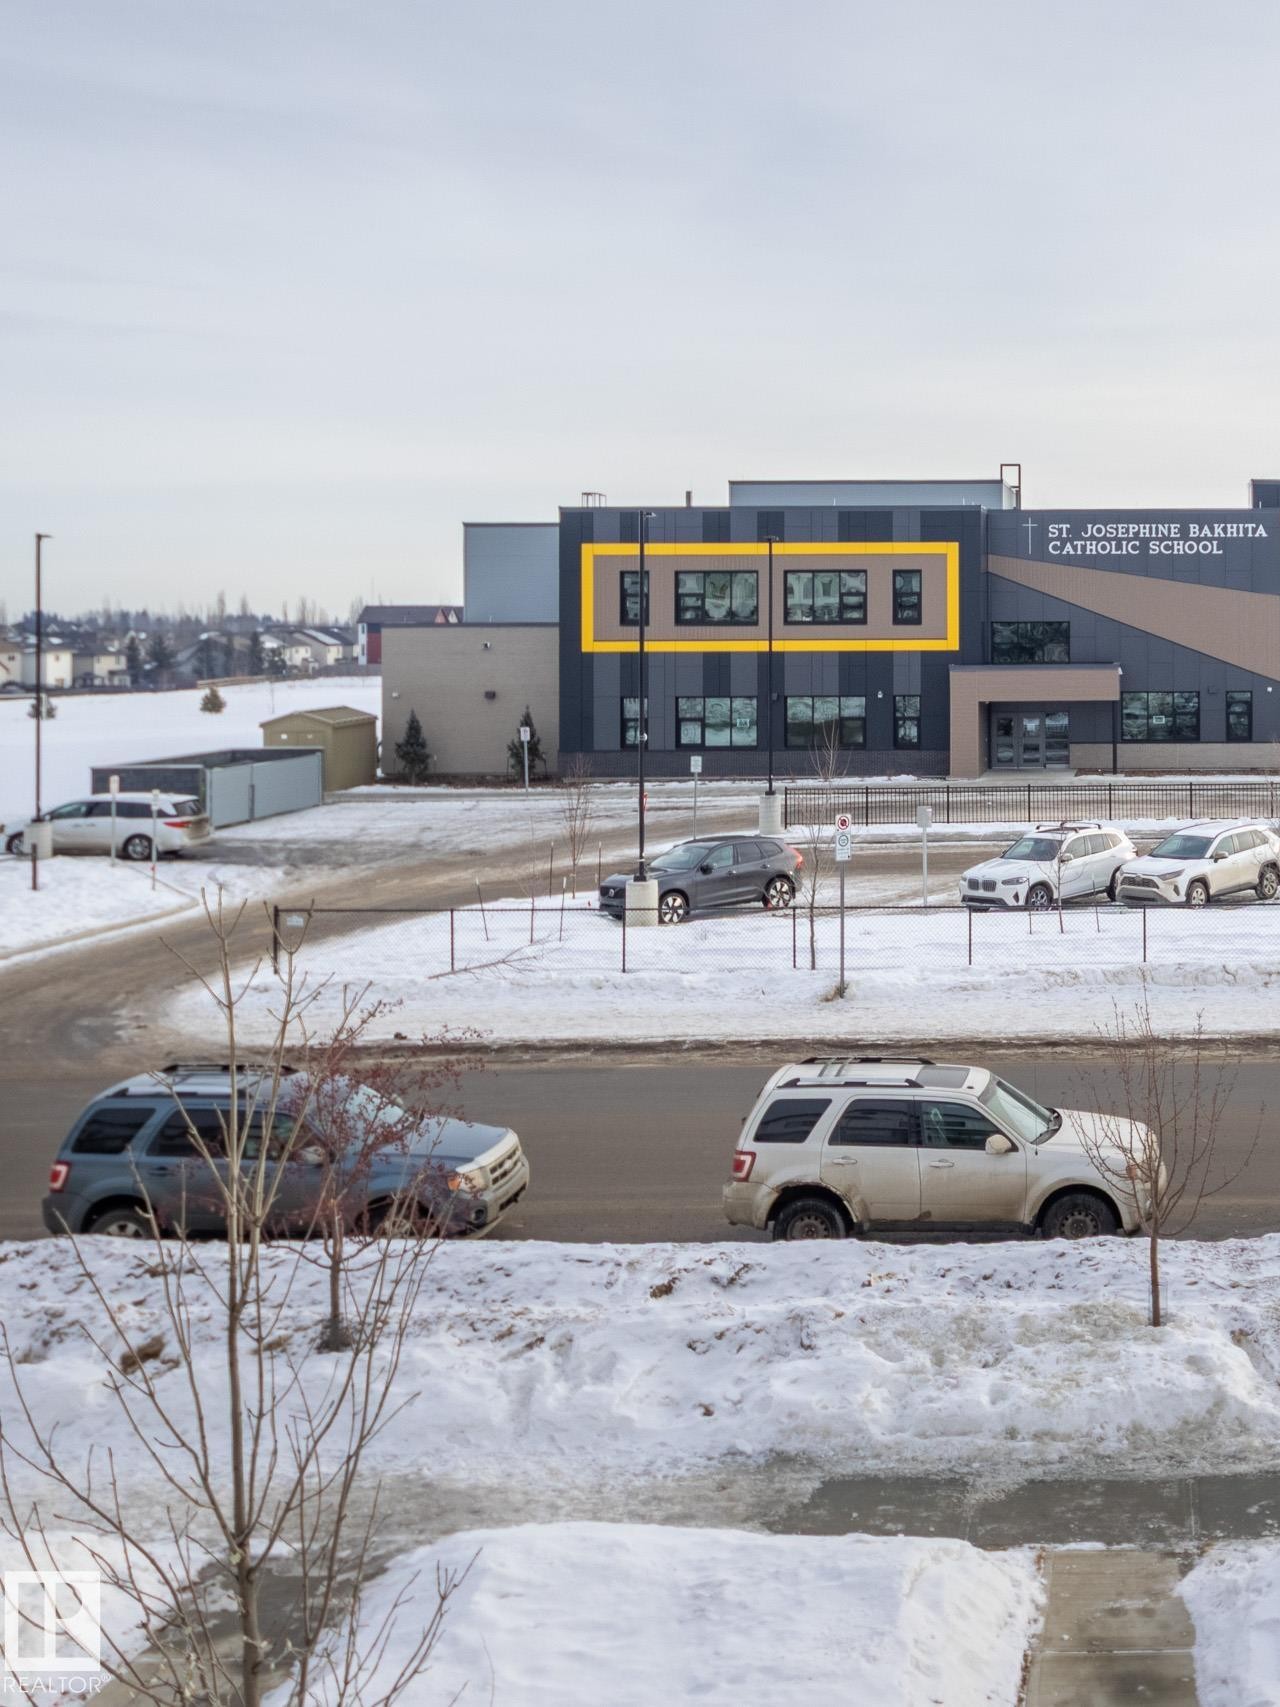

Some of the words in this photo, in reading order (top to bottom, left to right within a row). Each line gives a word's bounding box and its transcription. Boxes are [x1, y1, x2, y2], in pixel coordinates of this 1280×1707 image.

[1048, 523, 1072, 538] ST.
[1081, 523, 1181, 538] JOSEPHINE
[1189, 523, 1268, 538] BAKHITA
[1048, 540, 1140, 555] CATHOLIC
[1149, 540, 1223, 555] SCHOOL
